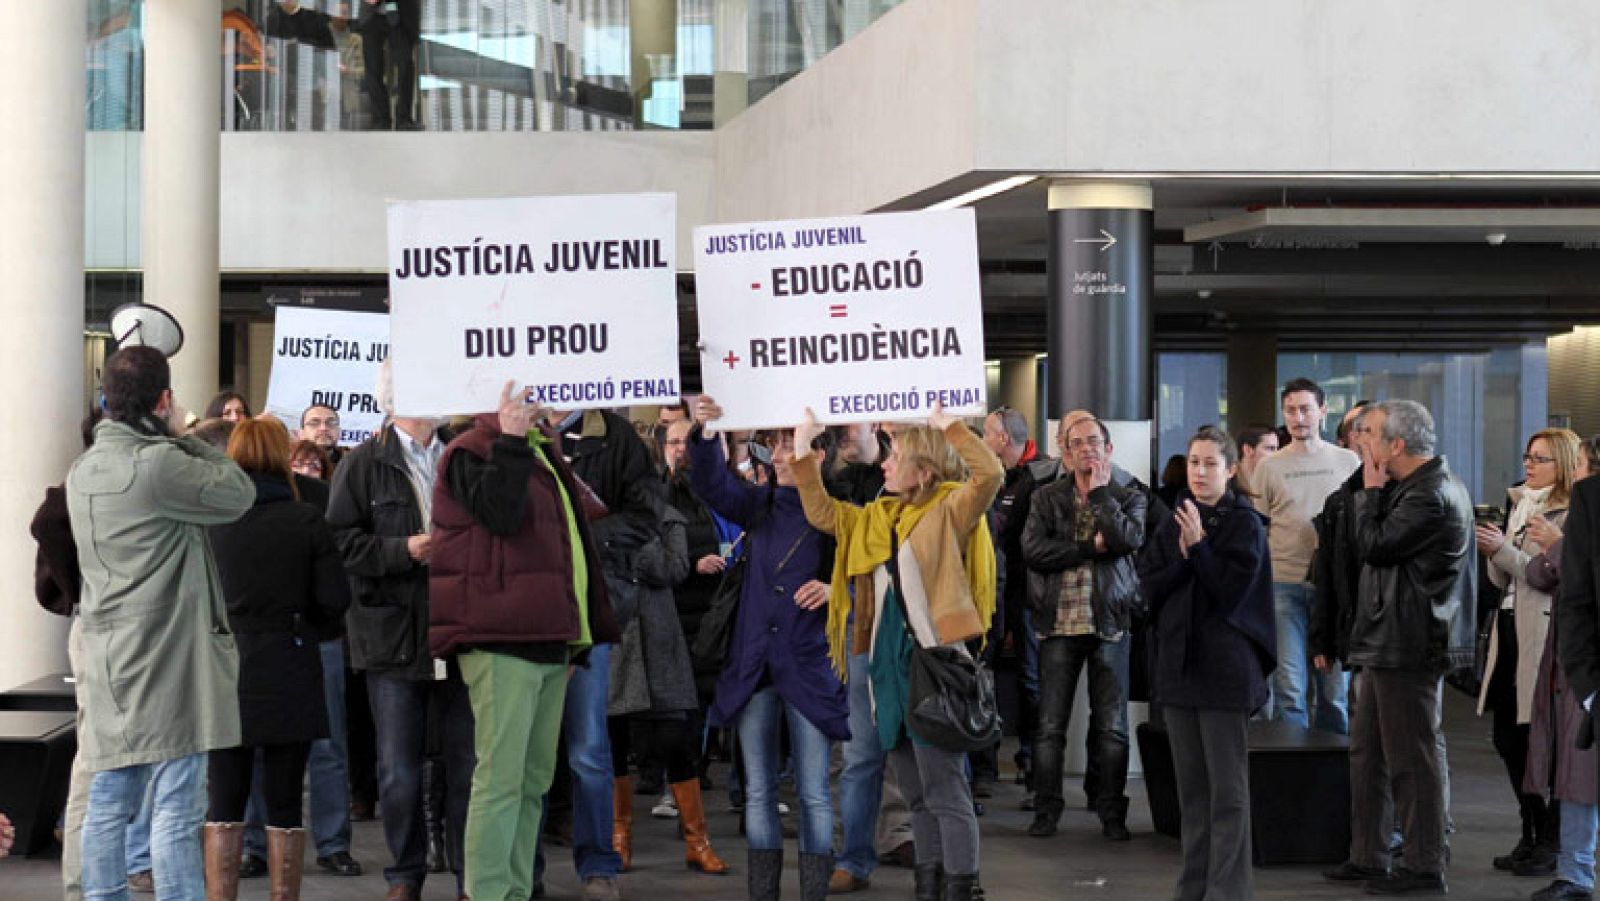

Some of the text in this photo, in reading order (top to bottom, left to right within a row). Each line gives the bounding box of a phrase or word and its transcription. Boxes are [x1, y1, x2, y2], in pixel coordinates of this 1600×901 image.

[705, 225, 867, 255] JUSTÍCIA JUVENIL
[395, 237, 668, 279] JUSTÍCIA JUVENIL
[771, 250, 924, 297] EDUCACIÓ
[1072, 283, 1086, 293] de
[1074, 271, 1107, 283] Jutjats
[278, 334, 360, 361] JUSTÍCIA
[464, 322, 609, 359] DIU PROU
[749, 323, 962, 368] REINCIDÈNCIA
[525, 376, 678, 404] EXECUCIÓ PENAL
[829, 386, 920, 415] EXECUCIÓ
